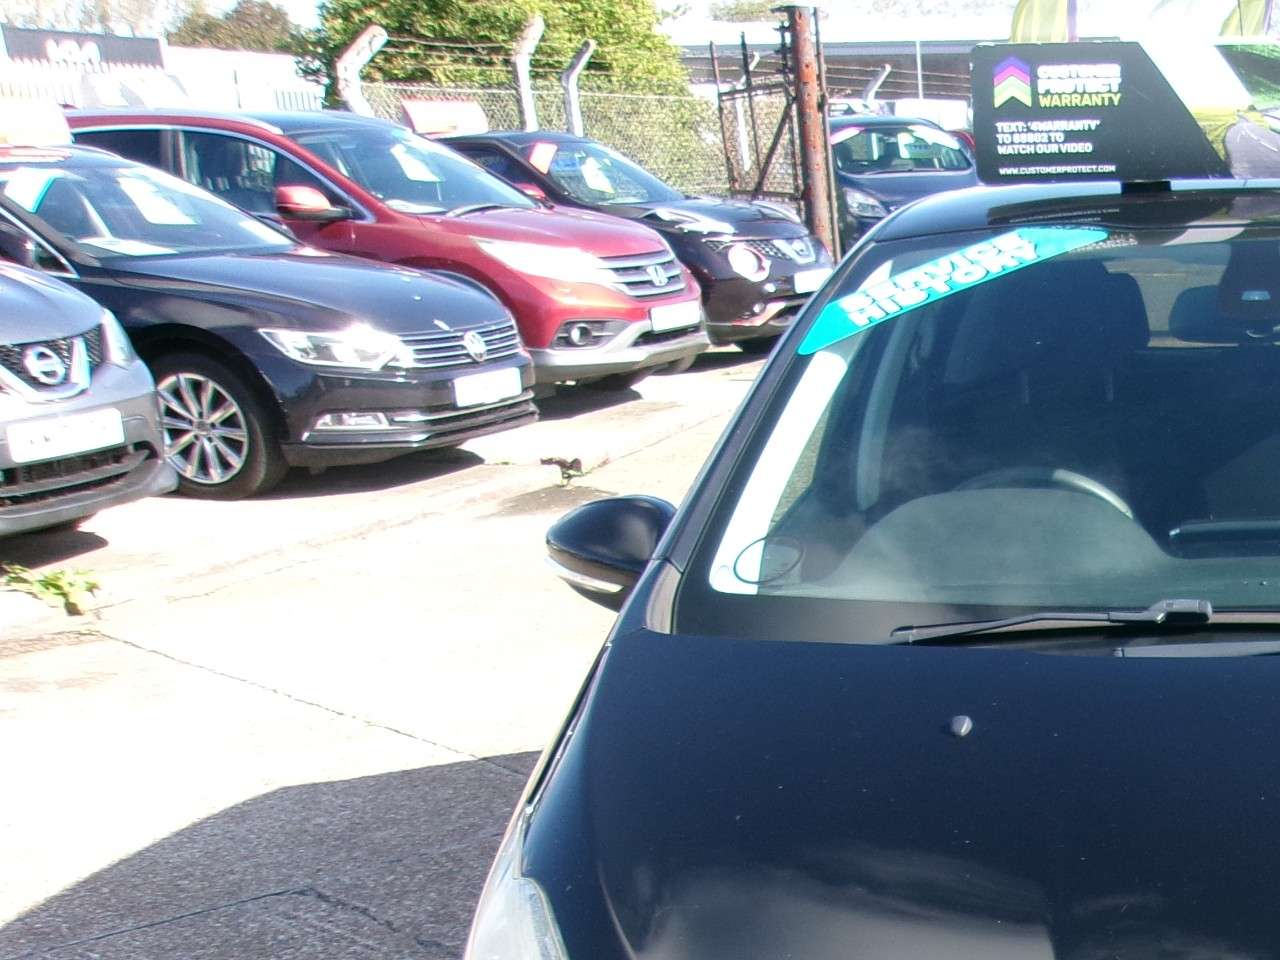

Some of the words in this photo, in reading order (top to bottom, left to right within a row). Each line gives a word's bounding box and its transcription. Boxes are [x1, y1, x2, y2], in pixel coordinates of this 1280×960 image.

[1038, 93, 1122, 107] WARRANTY
[996, 133, 1012, 144] TO
[1048, 131, 1065, 143] TO
[997, 144, 1034, 155] WATCH
[1035, 143, 1058, 154] OUR
[1058, 142, 1093, 153] VIDEO
